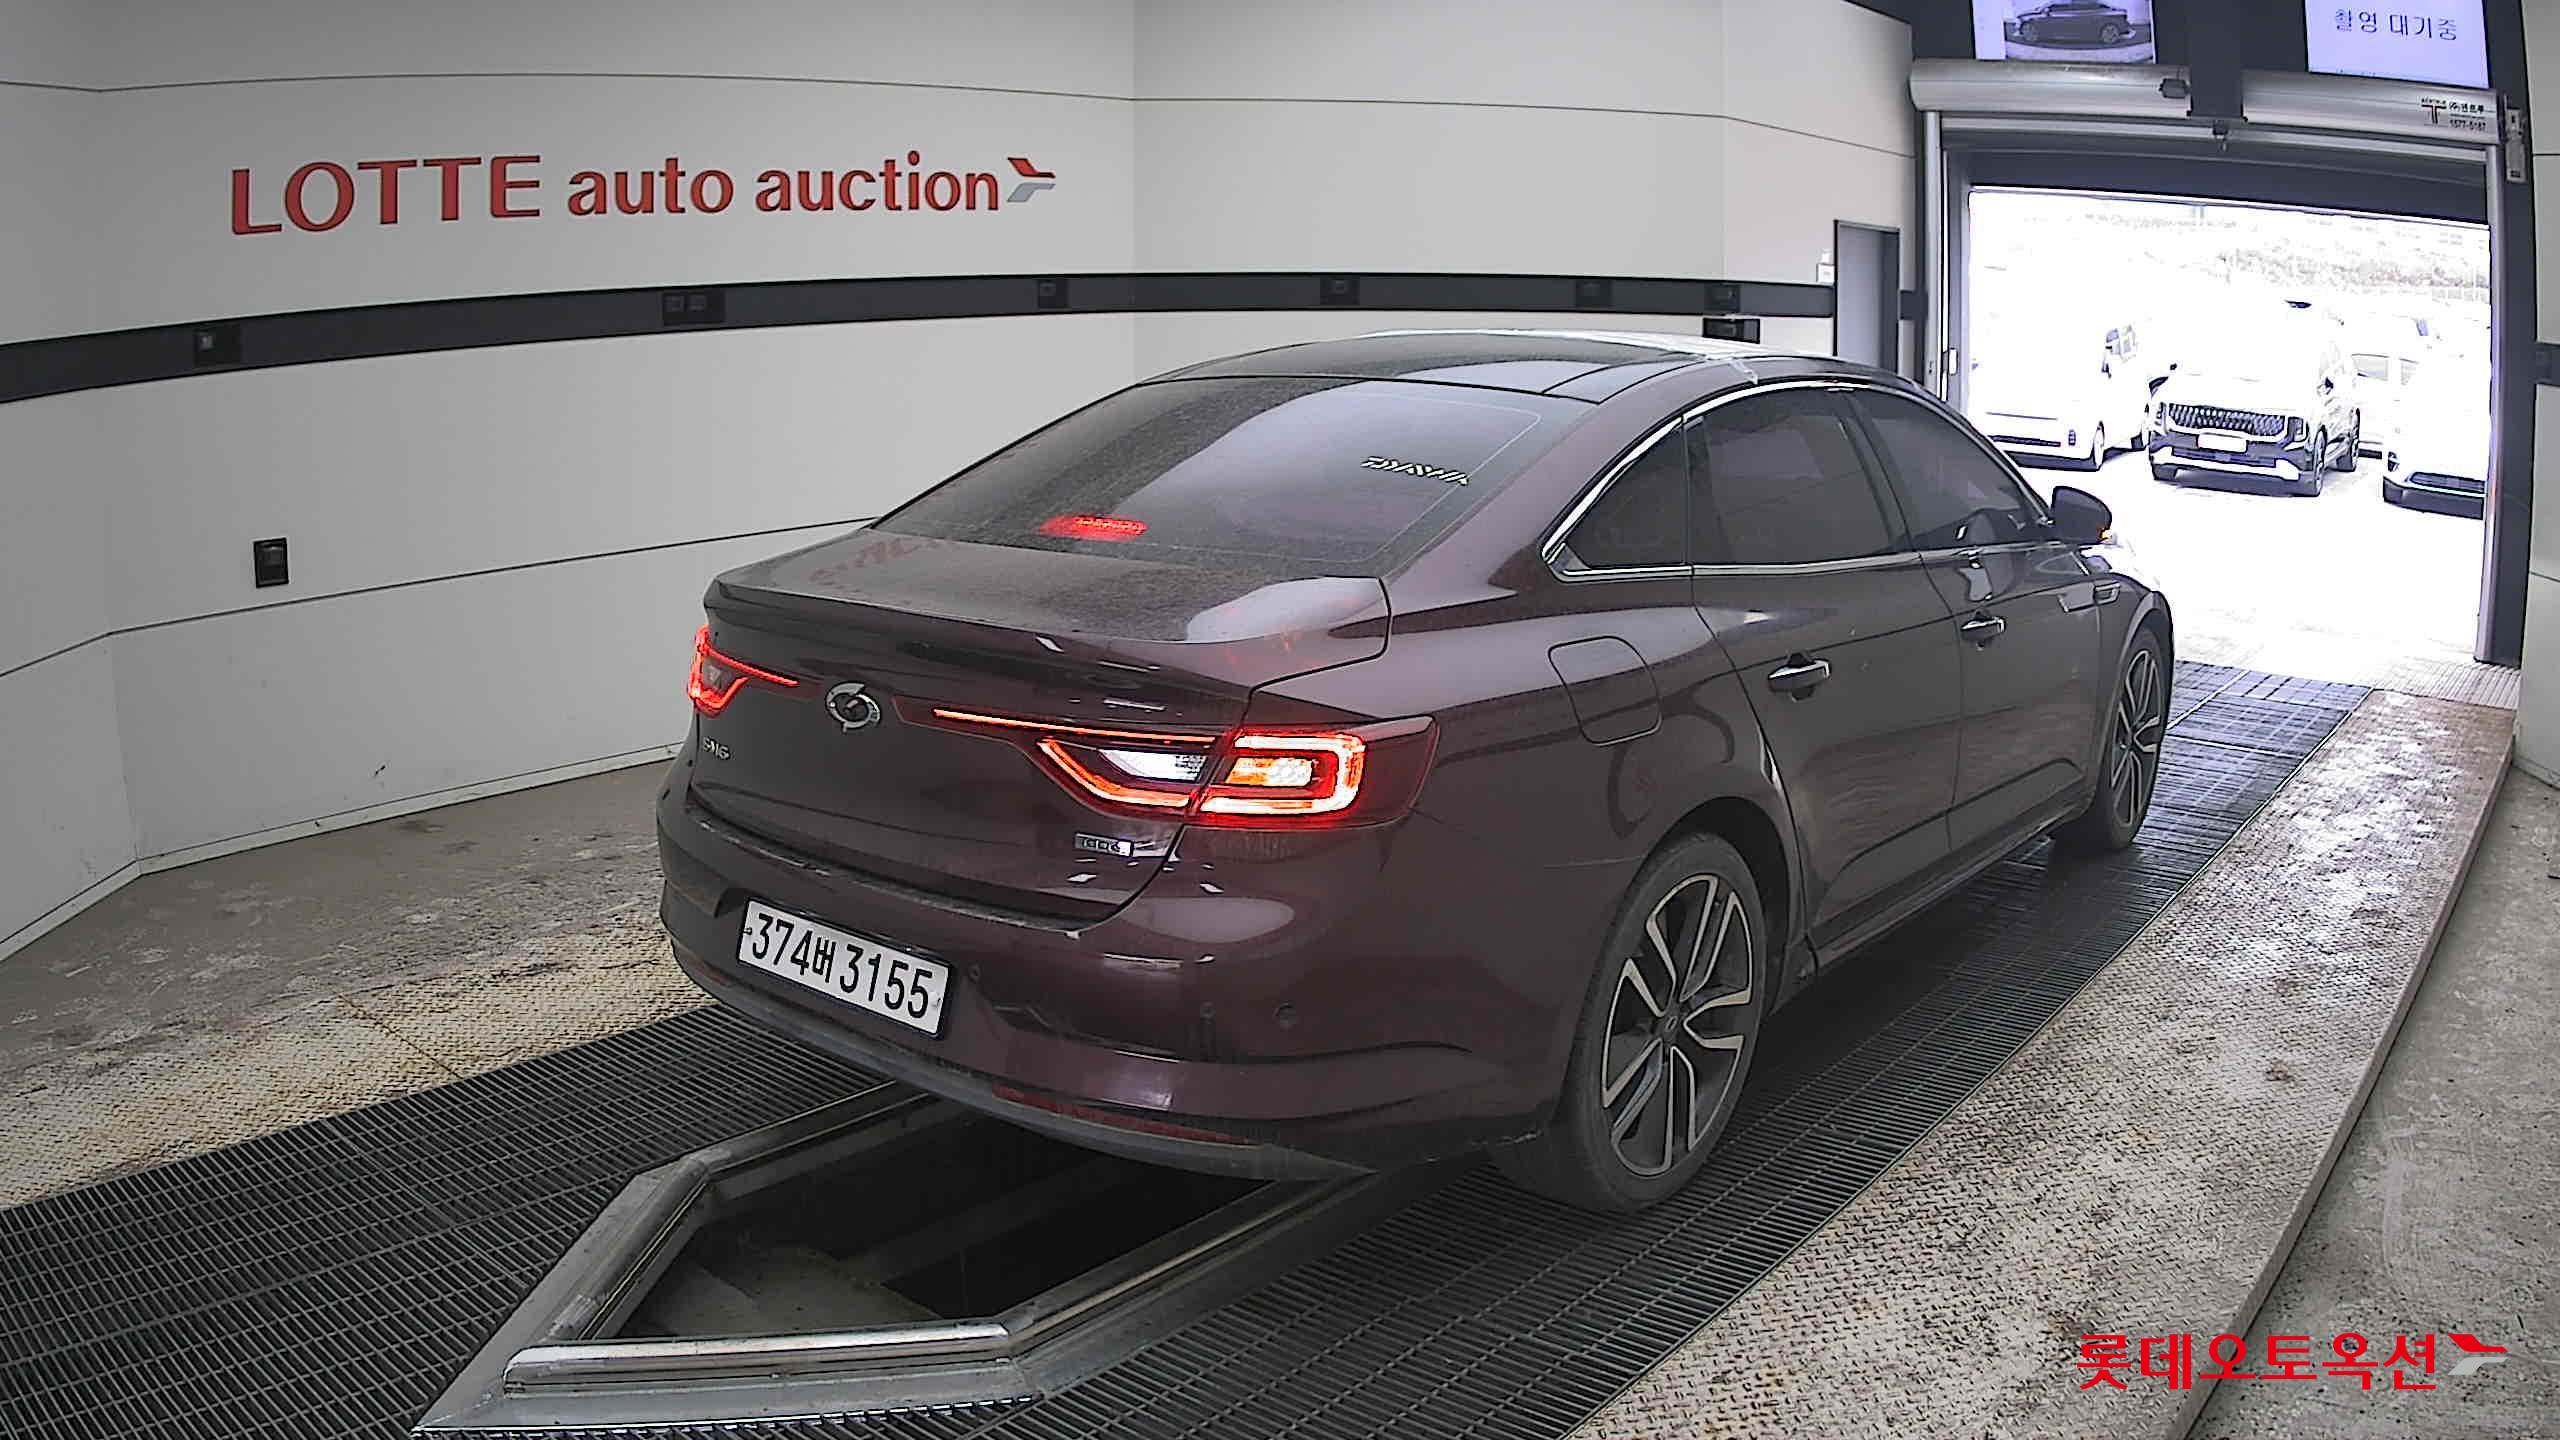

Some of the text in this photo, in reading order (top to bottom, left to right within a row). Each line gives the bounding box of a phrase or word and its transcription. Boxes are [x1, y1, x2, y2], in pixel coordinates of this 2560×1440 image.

[2389, 13, 2457, 41] 대기중
[231, 150, 999, 235] LOTTE auto auction
[840, 943, 933, 1018] 3155
